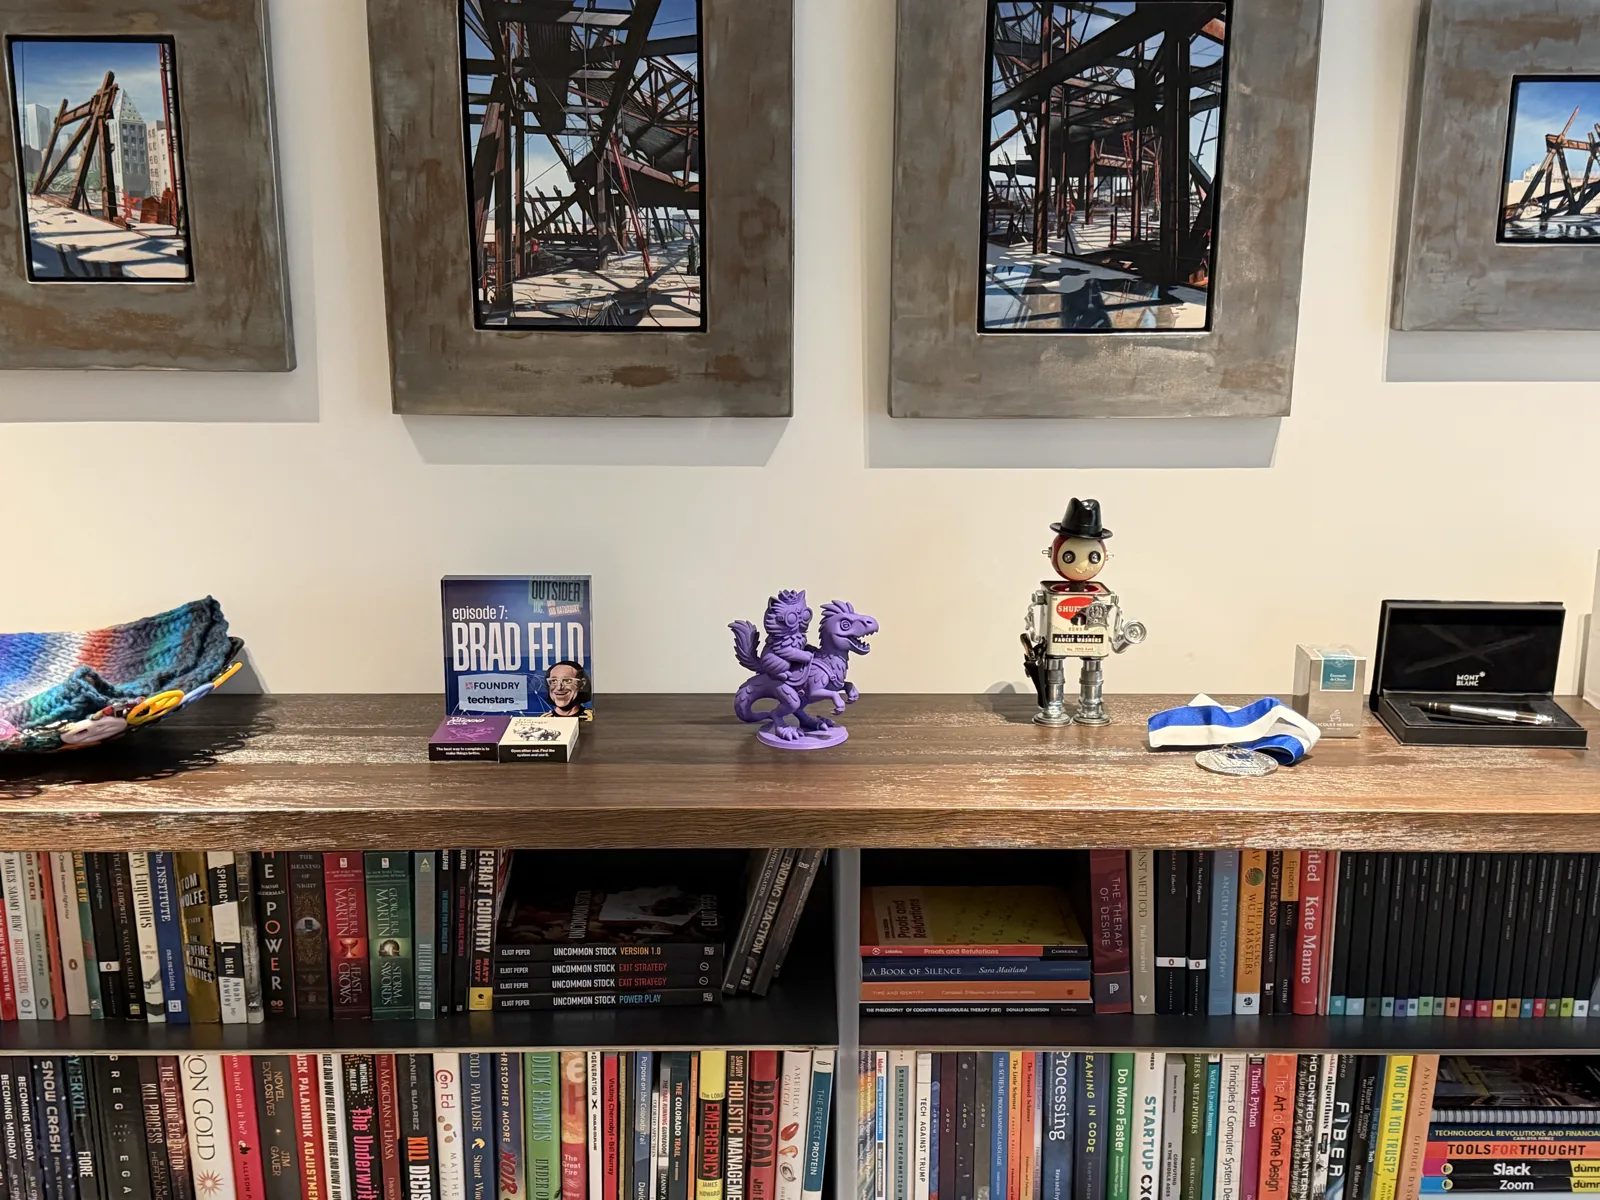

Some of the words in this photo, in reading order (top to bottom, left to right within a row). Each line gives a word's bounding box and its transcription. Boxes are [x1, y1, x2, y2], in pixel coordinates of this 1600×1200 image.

[532, 580, 581, 601] OUTSIDER
[452, 607, 496, 621] episode
[499, 606, 508, 619] 7:
[452, 623, 521, 672] BRAD
[468, 696, 514, 704] techstars
[771, 857, 792, 897] FINDING
[1112, 878, 1121, 898] THE
[1287, 860, 1297, 897] Epictetus
[134, 874, 152, 929] Eugenides
[157, 866, 171, 922] INSTITUTE
[1100, 888, 1108, 901] OF
[335, 888, 347, 936] MARTIN
[376, 889, 390, 936] MARTIN
[476, 899, 492, 952] COUNTRY
[752, 901, 778, 954] TRACTION
[1100, 907, 1110, 946] DESIRE
[1112, 903, 1122, 953] THERAPY
[1269, 901, 1277, 925] SAND
[1304, 896, 1317, 930] Kate
[225, 958, 234, 974] MEN
[418, 944, 432, 971] WILLIAM
[554, 948, 593, 956] UNCOMMON
[595, 947, 617, 955] STOCK
[620, 947, 649, 955] VERSION
[651, 947, 661, 955] 1.0
[1245, 929, 1254, 975] MASTERS
[1301, 935, 1316, 984] Manne
[338, 963, 351, 1004] CROWS
[351, 967, 361, 992] FEAST
[381, 962, 392, 1005] SWORDS
[552, 965, 591, 973] UNCOMMON
[594, 964, 615, 973] STOCK
[619, 964, 632, 972] EXIT
[635, 963, 667, 971] STRATEGY
[552, 980, 591, 988] UNCOMMON
[594, 979, 615, 987] STOCK
[619, 978, 632, 986] EXIT
[635, 978, 667, 986] STRATEGY
[997, 966, 1028, 974] Maitland
[418, 975, 432, 999] GIBSON
[553, 997, 593, 1005] UNCOMMON
[595, 996, 615, 1005] STOCK
[619, 995, 642, 1003] POWER
[645, 995, 661, 1003] PLAY
[41, 1061, 56, 1102] SNOW
[161, 1066, 173, 1082] THE
[274, 1071, 284, 1101] NOVEL
[349, 1069, 357, 1091] MILLER
[360, 1064, 369, 1094] MICHELLE
[532, 1056, 551, 1086] DICK
[1117, 1069, 1128, 1084] Do
[1228, 1065, 1239, 1103] Principles
[1251, 1069, 1261, 1095] Think
[1275, 1074, 1289, 1092] The
[1394, 1065, 1409, 1088] WHO
[1, 1074, 13, 1120] BECOMING
[18, 1076, 30, 1121] BECOMING
[142, 1084, 158, 1100] KILL
[163, 1086, 177, 1119] TURING
[262, 1061, 275, 1116] EXPLOSIVES
[441, 1094, 455, 1108] Ed
[1116, 1087, 1128, 1115] More
[1273, 1095, 1286, 1112] Art
[1305, 1075, 1316, 1132] CONTROLS
[1323, 1076, 1334, 1129] algorithms
[1391, 1092, 1404, 1112] CAN
[299, 1078, 313, 1137] PALAHNIUK
[411, 1090, 420, 1131] SUAREZ
[470, 1084, 482, 1132] PARADISE
[532, 1090, 552, 1141] FRANCIS
[728, 1080, 744, 1134] HOLISTIC
[1088, 1105, 1096, 1116] IN
[1191, 1083, 1200, 1134] METAPHORS
[1228, 1105, 1238, 1114] of
[1249, 1097, 1259, 1127] Python
[1273, 1115, 1284, 1125] of
[47, 1106, 61, 1153] CRASH
[144, 1104, 163, 1144] PROCESS
[193, 1099, 215, 1160] GOLD
[502, 1110, 510, 1142] MOORE
[813, 1107, 823, 1140] PERFECT
[1086, 1122, 1096, 1153] CODE
[1115, 1118, 1126, 1153] Faster
[1142, 1096, 1156, 1170] STARTUP
[1225, 1116, 1236, 1155] Computer
[1329, 1101, 1350, 1177] FIBER
[1388, 1116, 1402, 1134] YOU
[5, 1122, 17, 1160] MONDAY
[23, 1123, 34, 1161] MONDAY
[167, 1122, 185, 1170] EXCEPTION
[407, 1136, 429, 1162] KILL
[703, 1103, 720, 1178] EMERGENCY
[1271, 1128, 1285, 1156] Game
[1303, 1137, 1311, 1157] THE
[1383, 1138, 1399, 1173] TRUST?
[78, 1151, 93, 1177] FIORE
[473, 1154, 483, 1178] Stuart
[499, 1148, 518, 1194] NOIR
[535, 1159, 549, 1189] UNDER
[810, 1141, 820, 1176] PROTEIN
[1223, 1158, 1234, 1185] System
[1493, 1163, 1531, 1176] Slack
[1265, 1160, 1283, 1192] Design
[1500, 1180, 1534, 1190] Zoom
